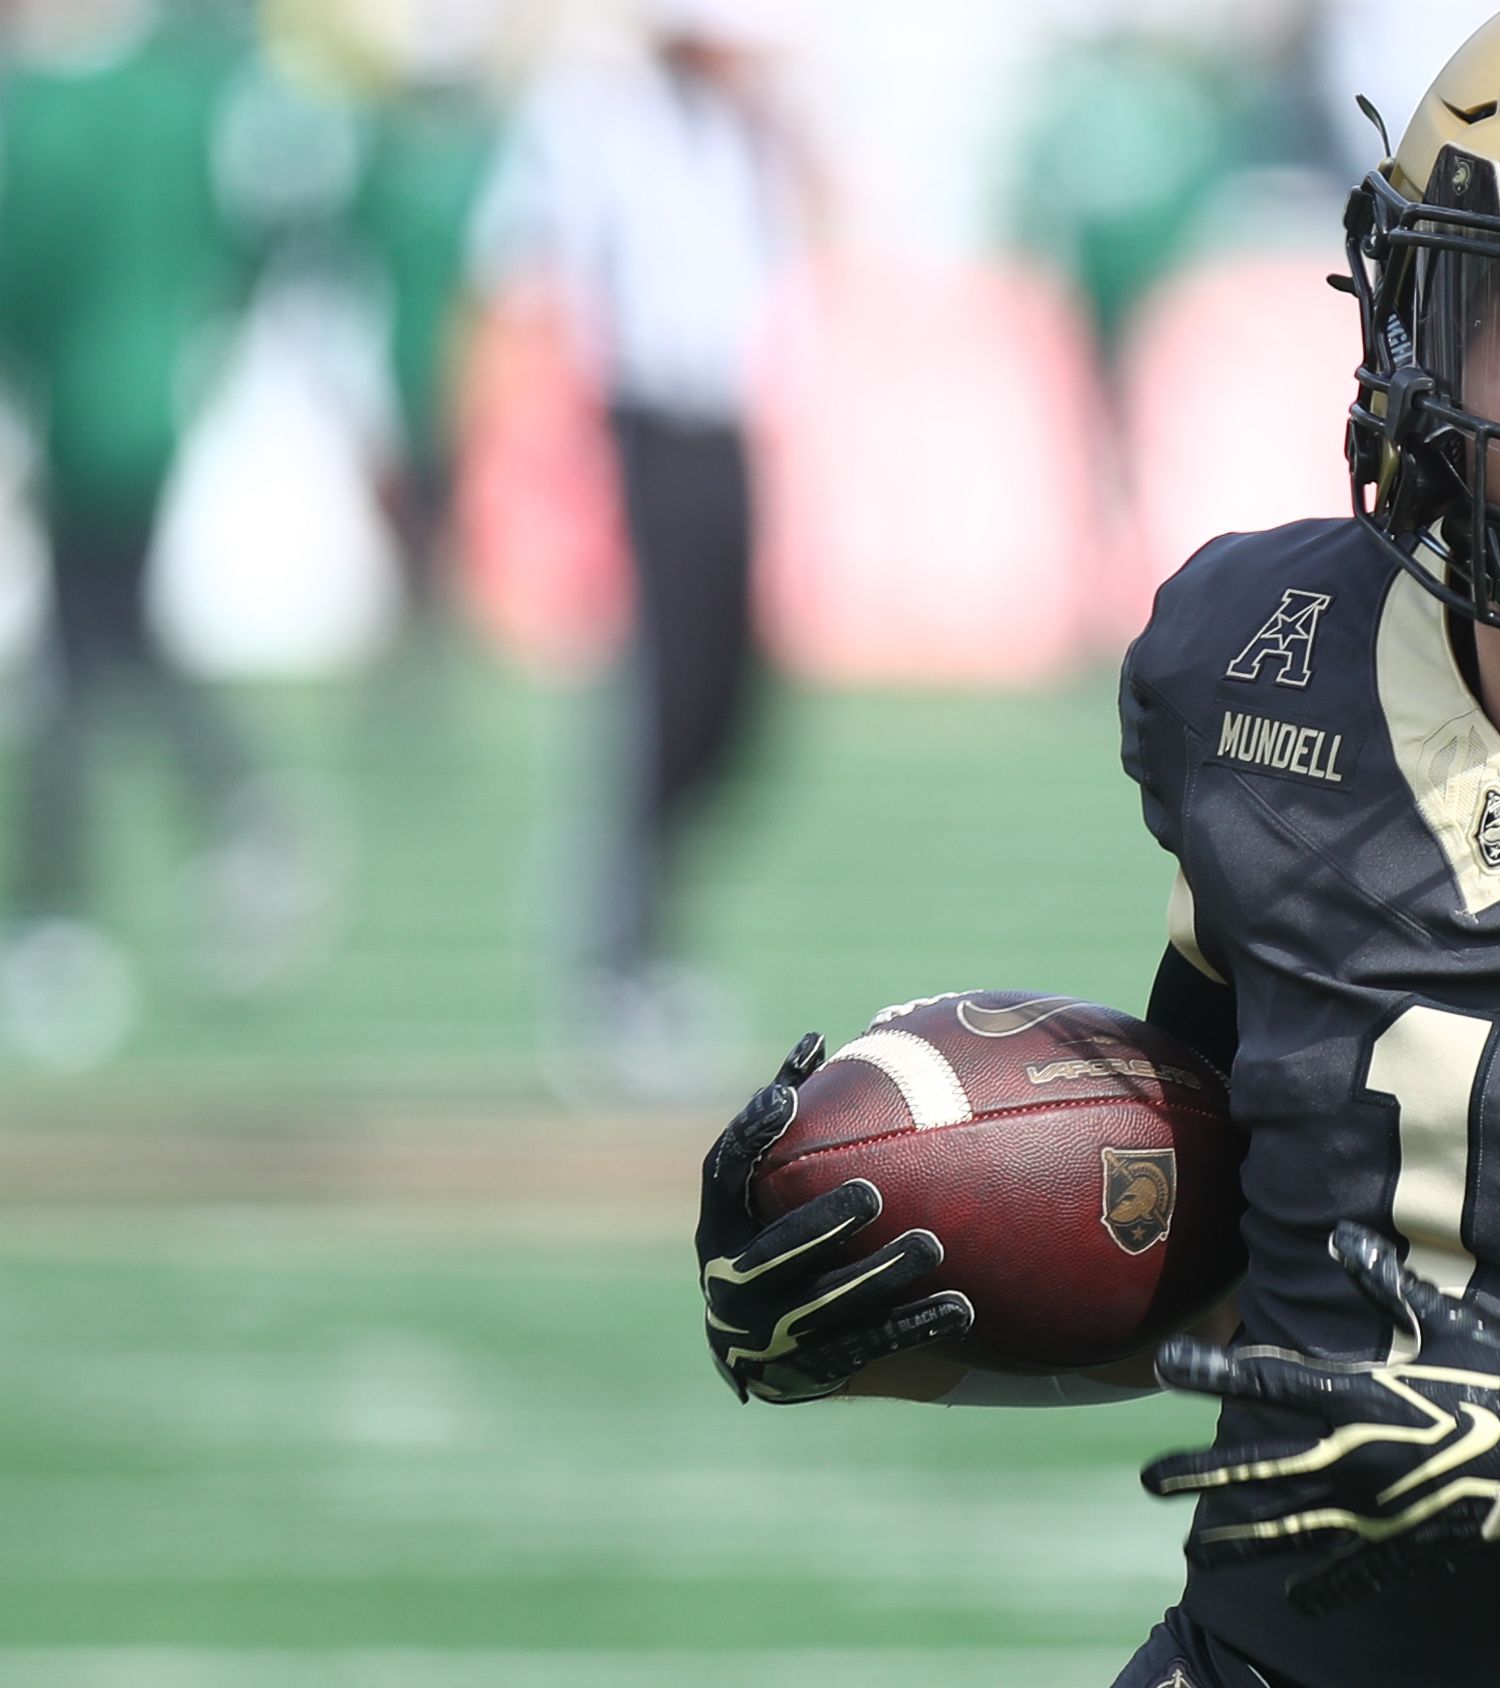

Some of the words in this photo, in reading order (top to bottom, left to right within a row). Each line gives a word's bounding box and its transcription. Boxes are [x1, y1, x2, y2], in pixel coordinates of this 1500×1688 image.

[1217, 711, 1342, 782] MUNDELL
[1363, 1003, 1495, 1299] 1
[898, 1307, 938, 1332] BLACK
